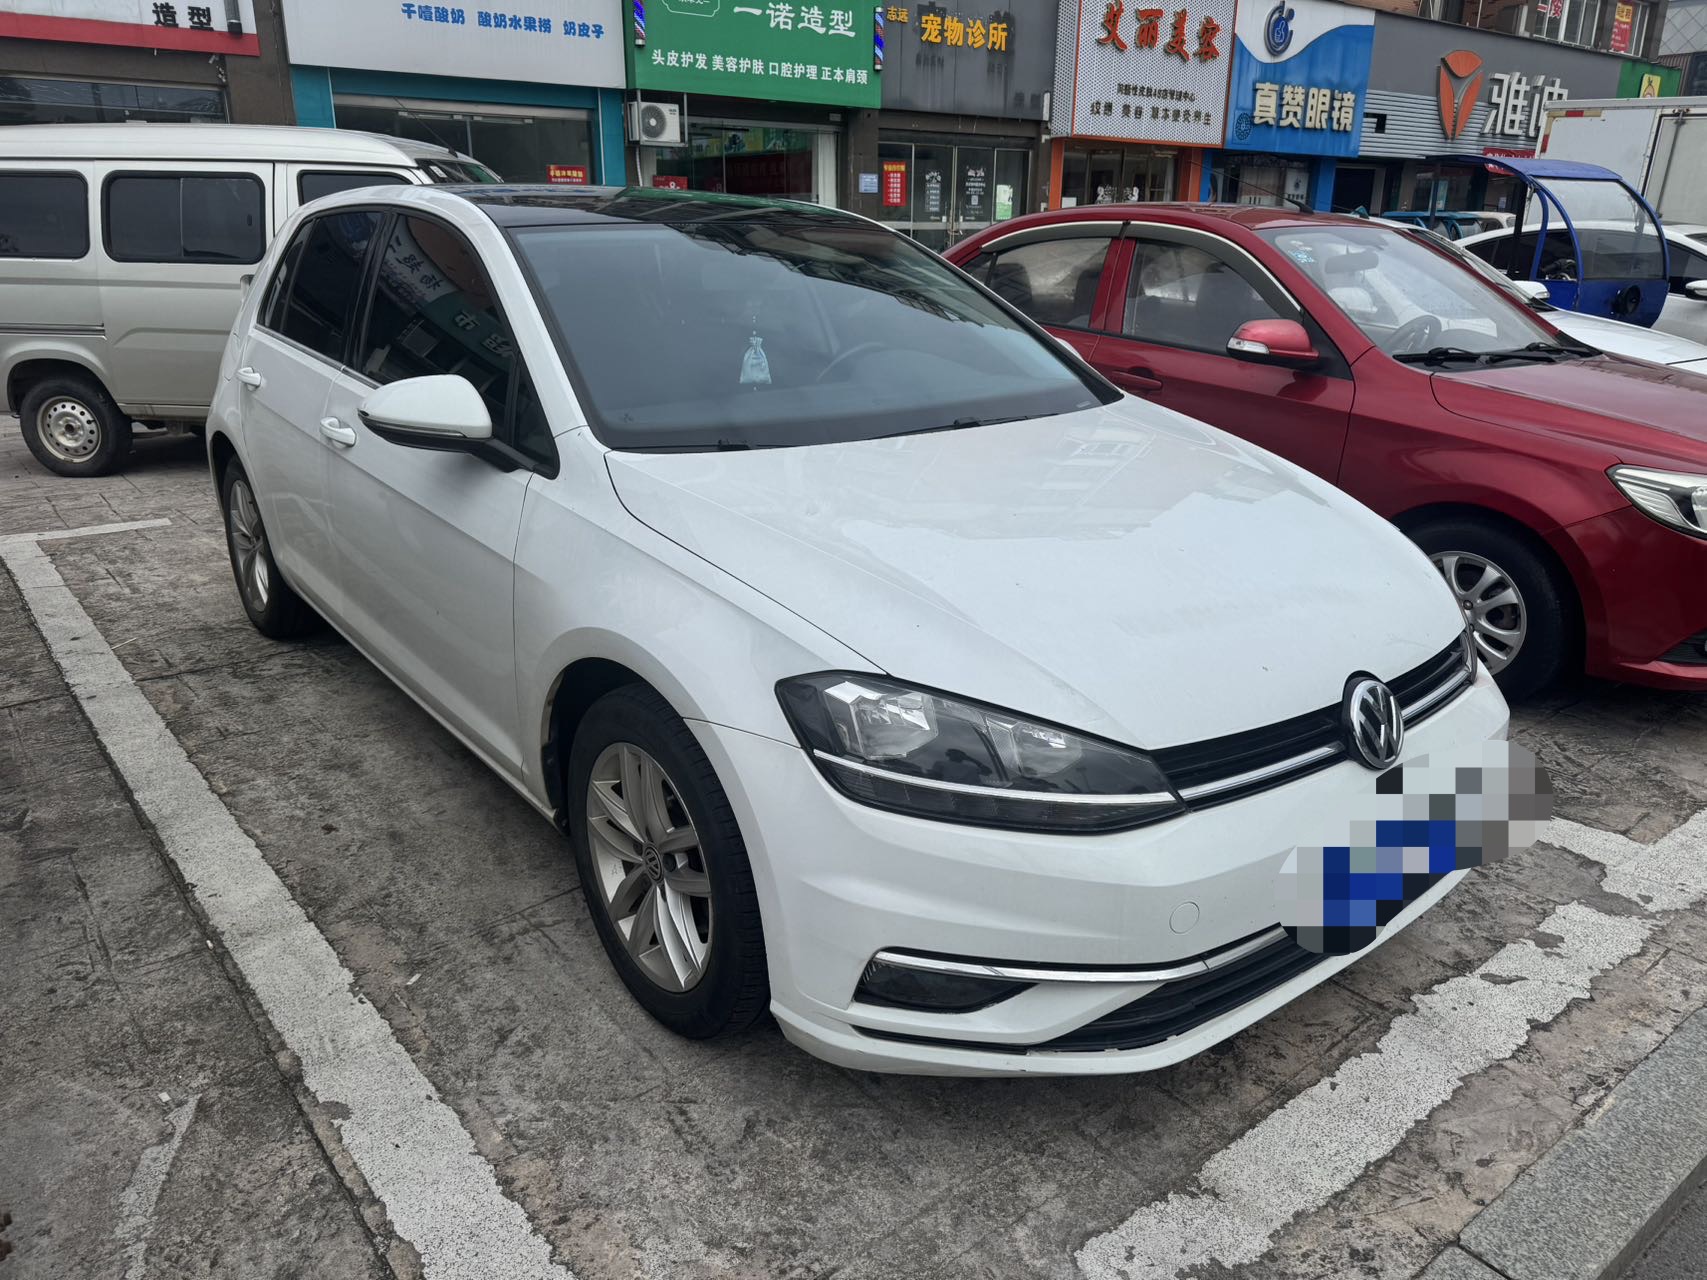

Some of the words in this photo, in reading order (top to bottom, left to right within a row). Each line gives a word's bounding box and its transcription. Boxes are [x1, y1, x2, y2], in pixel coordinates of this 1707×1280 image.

[152, 2, 214, 32] 造型
[401, 3, 465, 25] 干噎酸奶
[477, 11, 552, 34] 酸奶水果捞
[563, 20, 605, 39] 奶皮子
[733, 2, 856, 37] 一诺造型
[921, 14, 1009, 51] 宠物诊所
[1097, 0, 1221, 62] 艾丽美容
[652, 49, 708, 70] 头皮护发
[711, 54, 765, 75] 美容护肤
[768, 61, 818, 80] 口腔护理
[820, 66, 868, 85] 正本肩颈
[1254, 82, 1355, 132] 真赞眼镜
